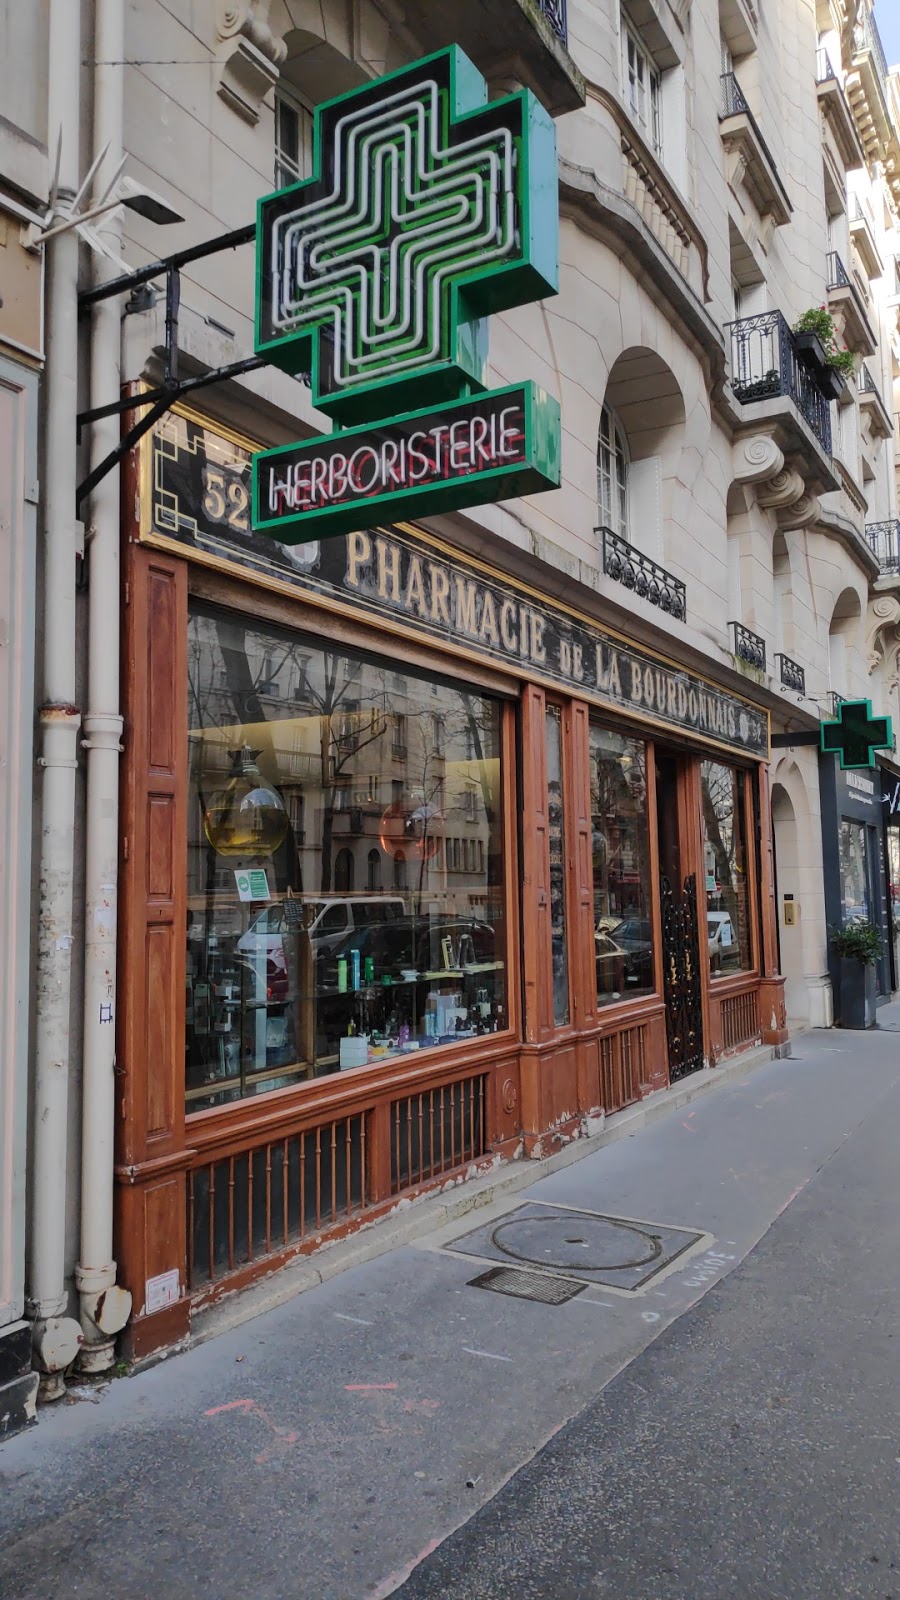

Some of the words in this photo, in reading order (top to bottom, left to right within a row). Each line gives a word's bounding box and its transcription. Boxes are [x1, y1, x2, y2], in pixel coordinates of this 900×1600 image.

[203, 472, 249, 530] 52
[267, 405, 522, 513] HERBORISTERIE
[346, 531, 548, 663] PHARMACIE
[559, 641, 584, 681] DE
[595, 645, 622, 695] LA
[631, 661, 737, 738] BOURDONNAIS
